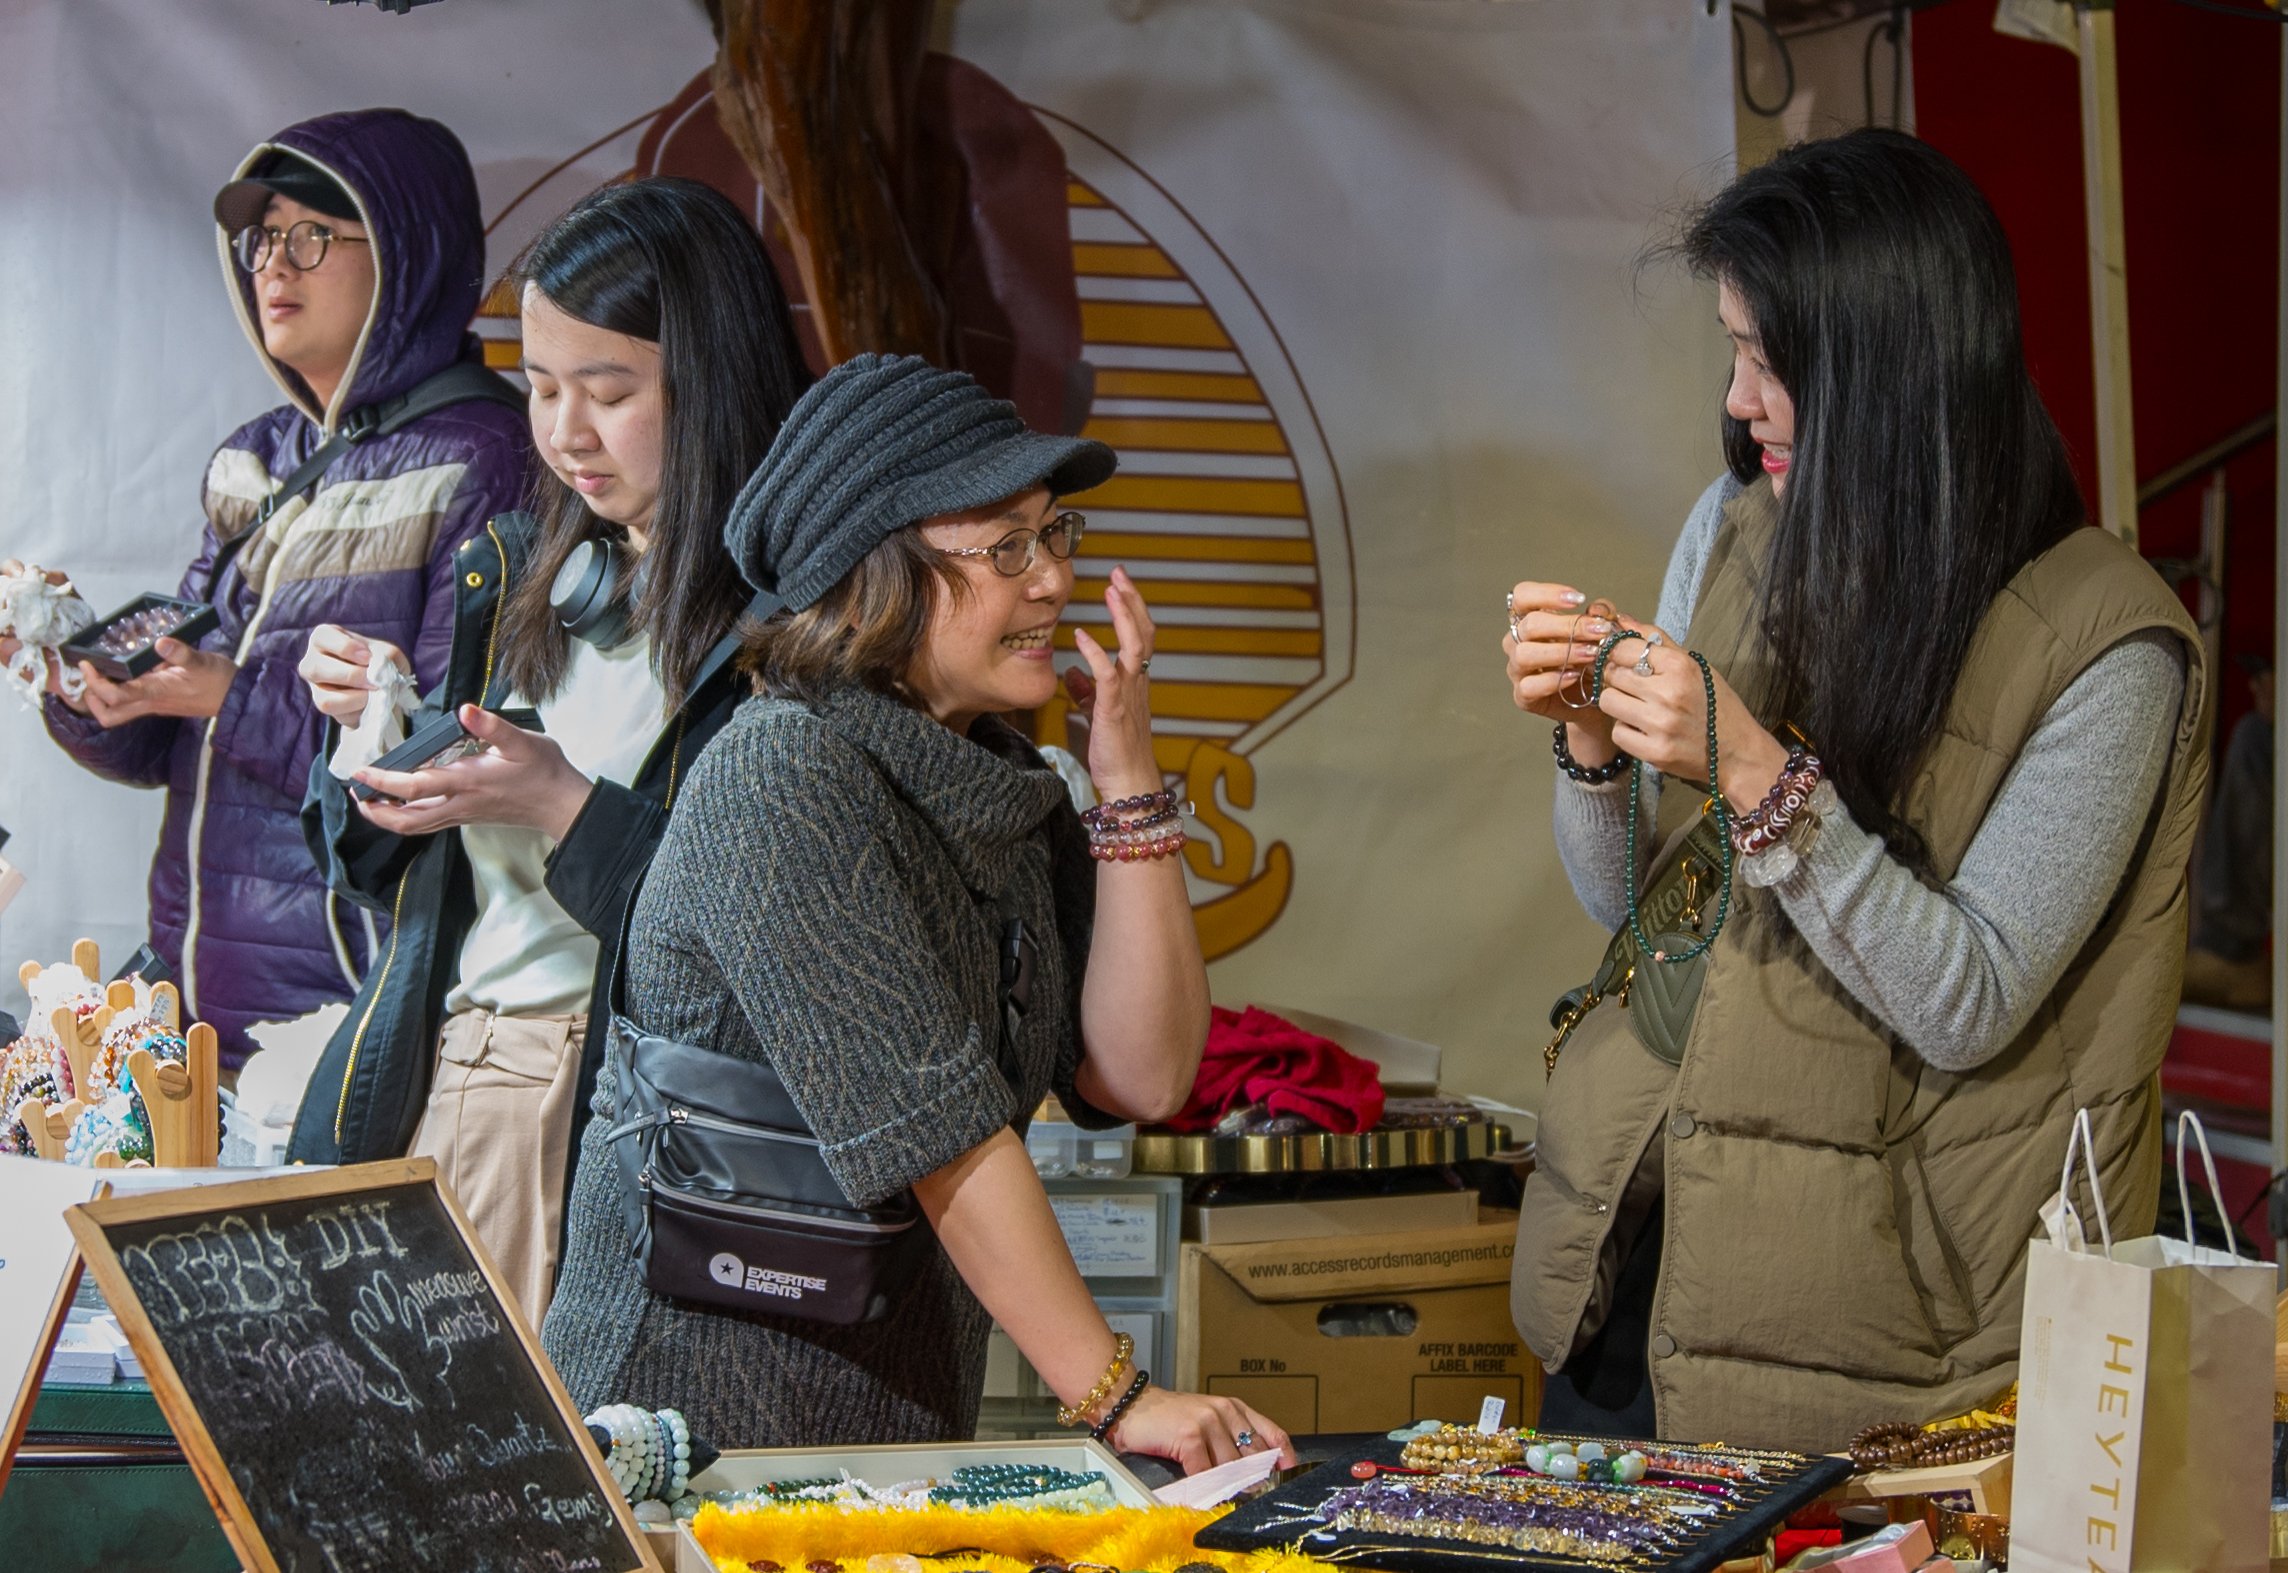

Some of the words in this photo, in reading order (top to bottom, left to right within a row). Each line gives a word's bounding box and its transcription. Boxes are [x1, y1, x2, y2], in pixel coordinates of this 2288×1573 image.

[306, 1202, 409, 1271] DIY
[407, 1268, 487, 1310] measure
[744, 1277, 803, 1300] EVENTS
[747, 1266, 827, 1292] EXPERTISE
[436, 1298, 500, 1343] wrist
[1418, 1343, 1455, 1358] AFFIX
[1457, 1342, 1518, 1358] BARCODE
[1240, 1358, 1266, 1373] BOX
[1269, 1358, 1286, 1373] No
[1430, 1359, 1470, 1373] LABEL
[1473, 1358, 1507, 1373] HERE
